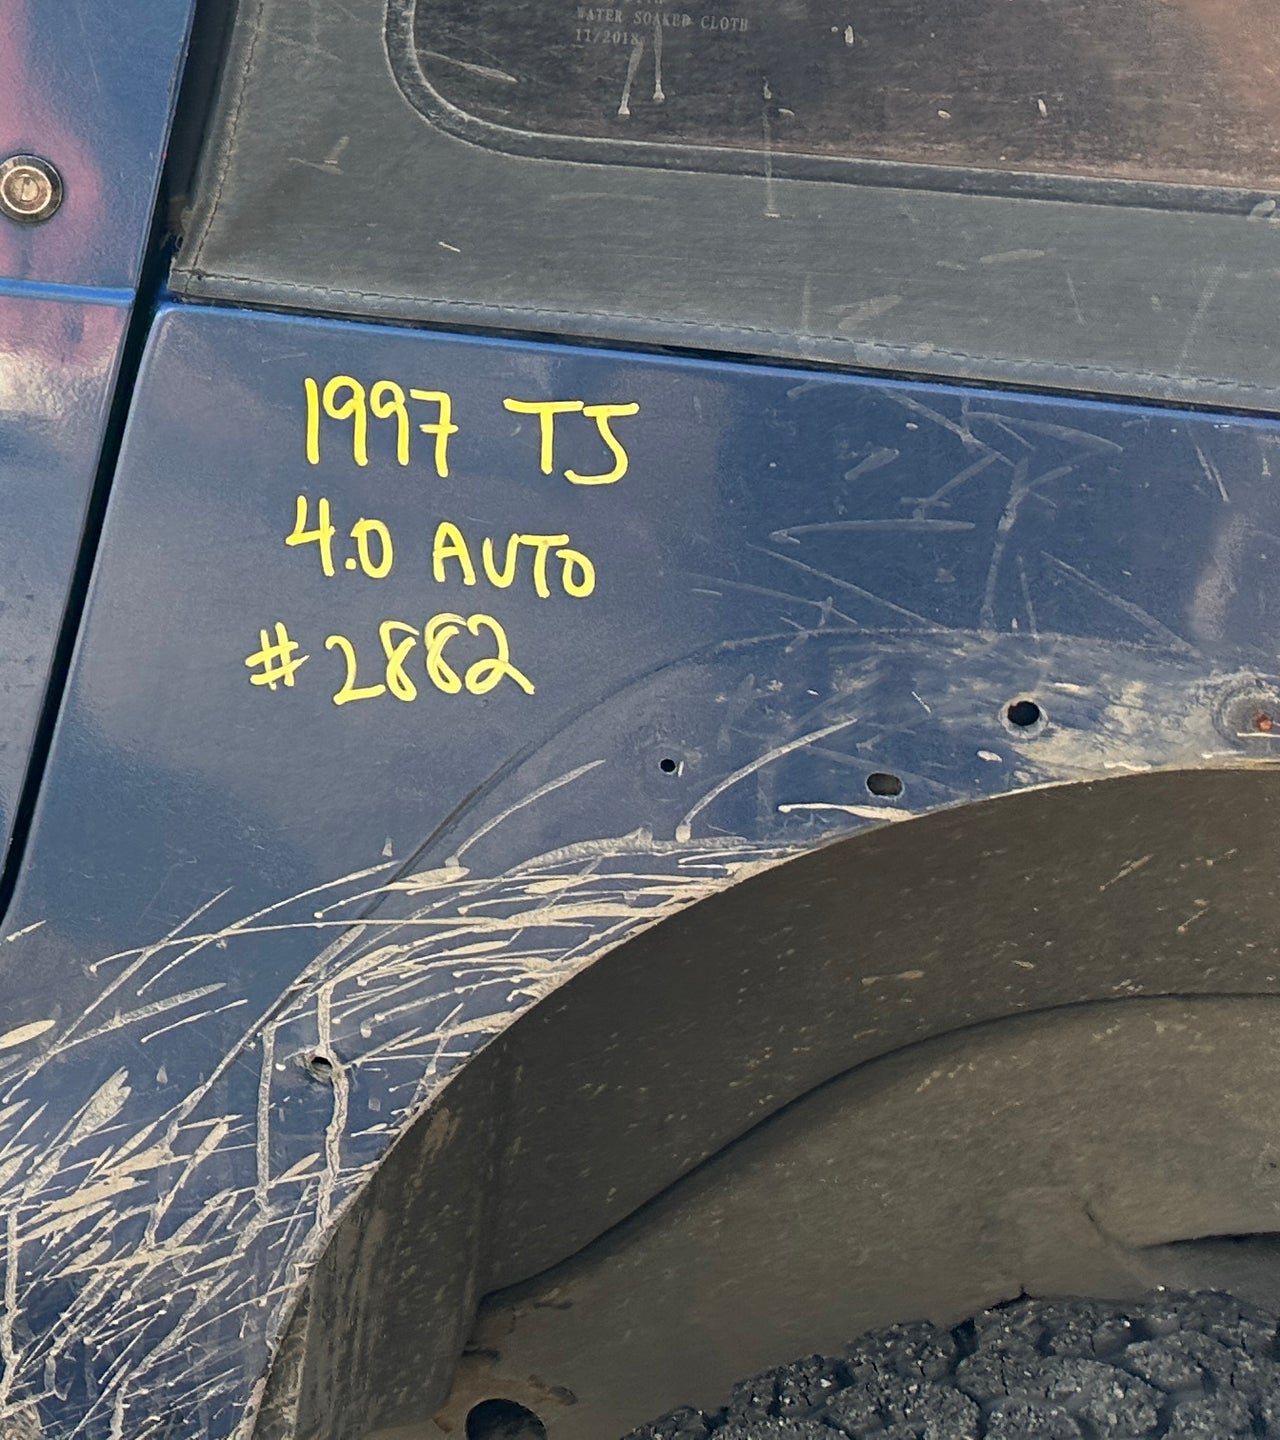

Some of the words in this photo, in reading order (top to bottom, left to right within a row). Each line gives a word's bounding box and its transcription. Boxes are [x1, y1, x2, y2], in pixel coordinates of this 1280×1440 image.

[576, 6, 623, 24] WATER
[633, 11, 692, 28] SOAKED
[700, 15, 749, 32] CLOTH
[304, 375, 460, 478] 1997
[502, 397, 641, 485] TJ
[284, 495, 395, 577] 4.0
[432, 521, 597, 599] AUTO
